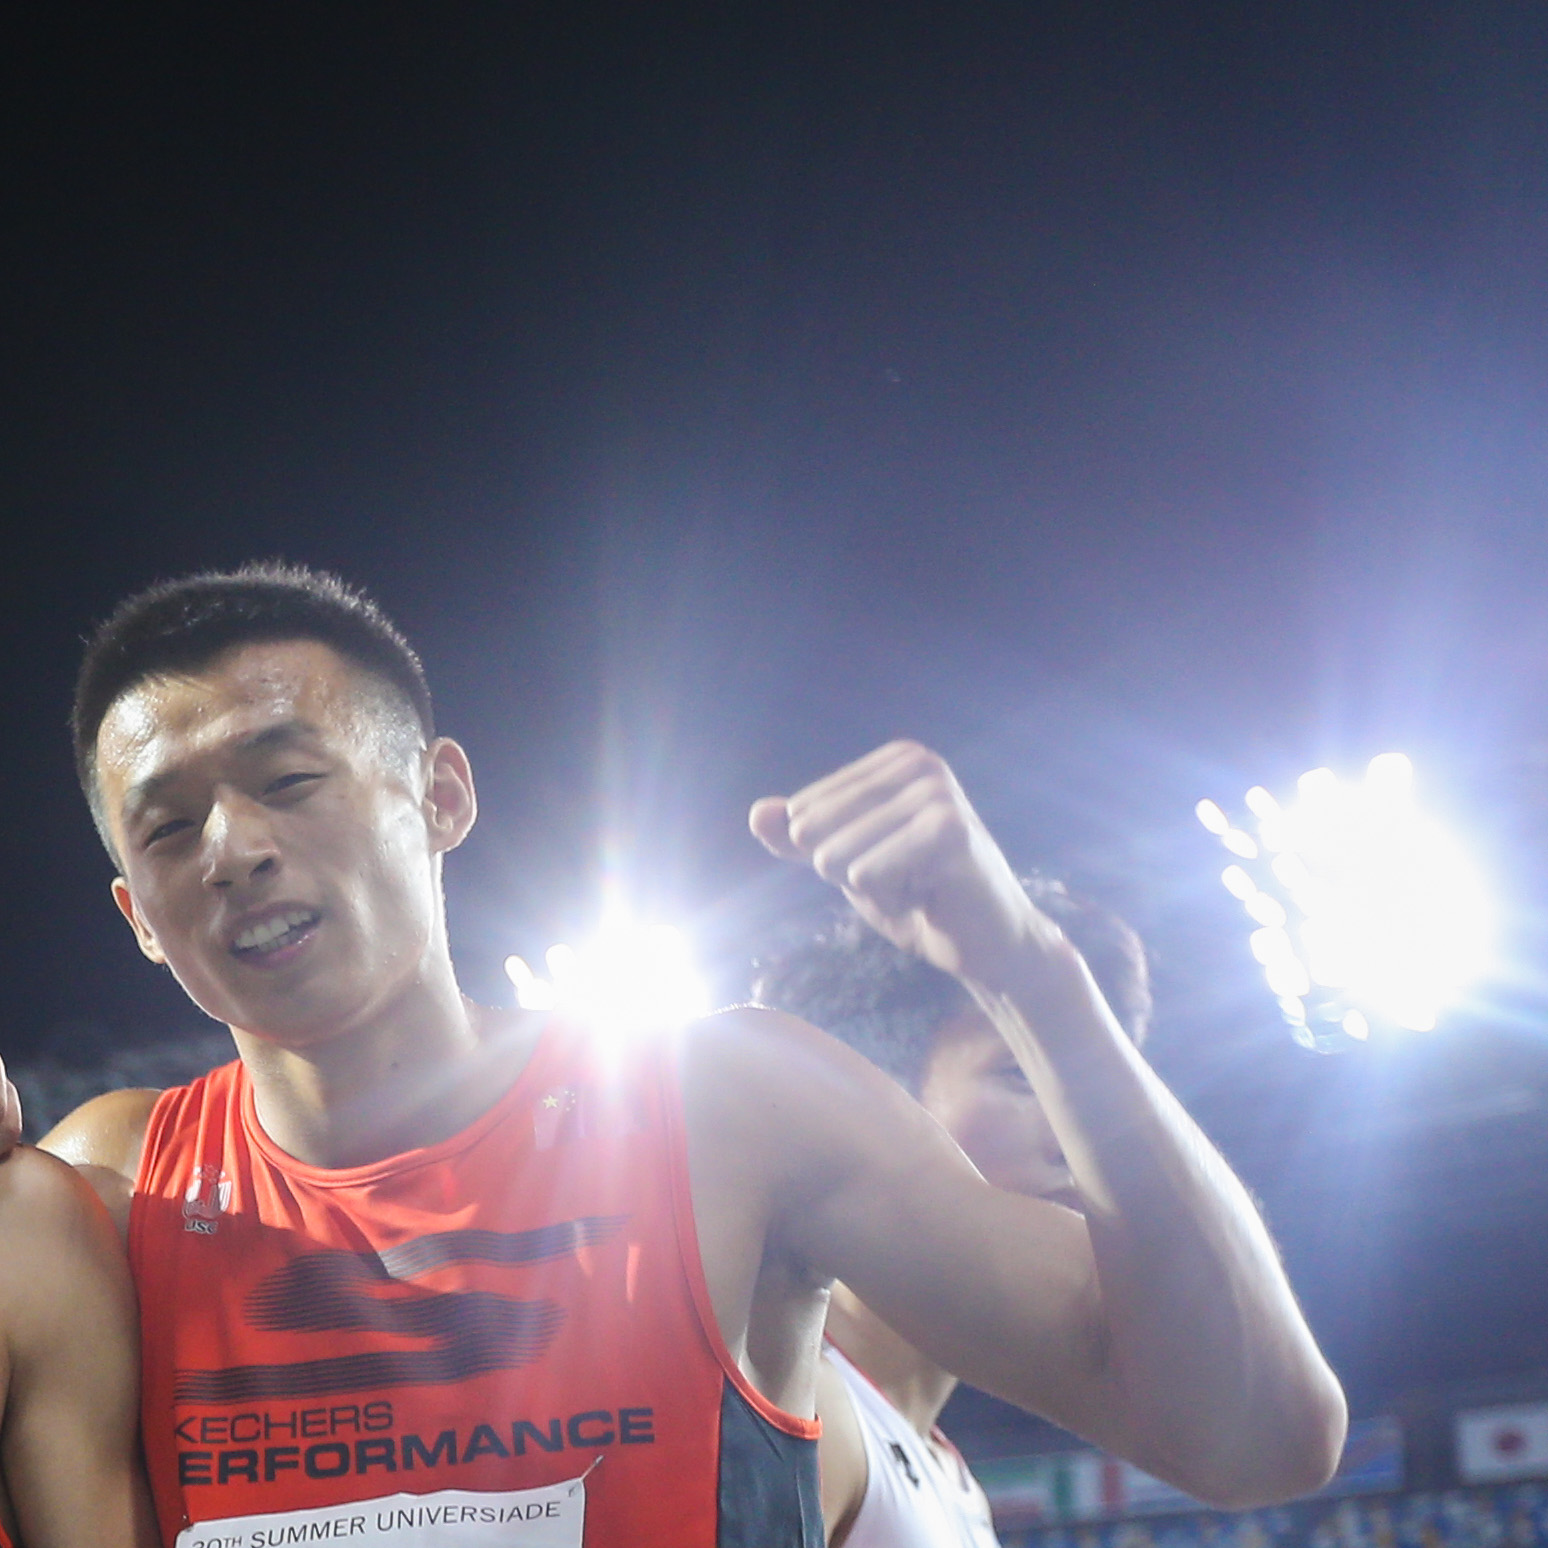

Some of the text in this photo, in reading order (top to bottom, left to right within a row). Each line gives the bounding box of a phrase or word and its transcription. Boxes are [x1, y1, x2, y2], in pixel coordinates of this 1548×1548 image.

[174, 1401, 394, 1444] KECHERS
[178, 1407, 655, 1486] ERFORMANCE
[377, 1501, 561, 1531] UNIVERSIADE
